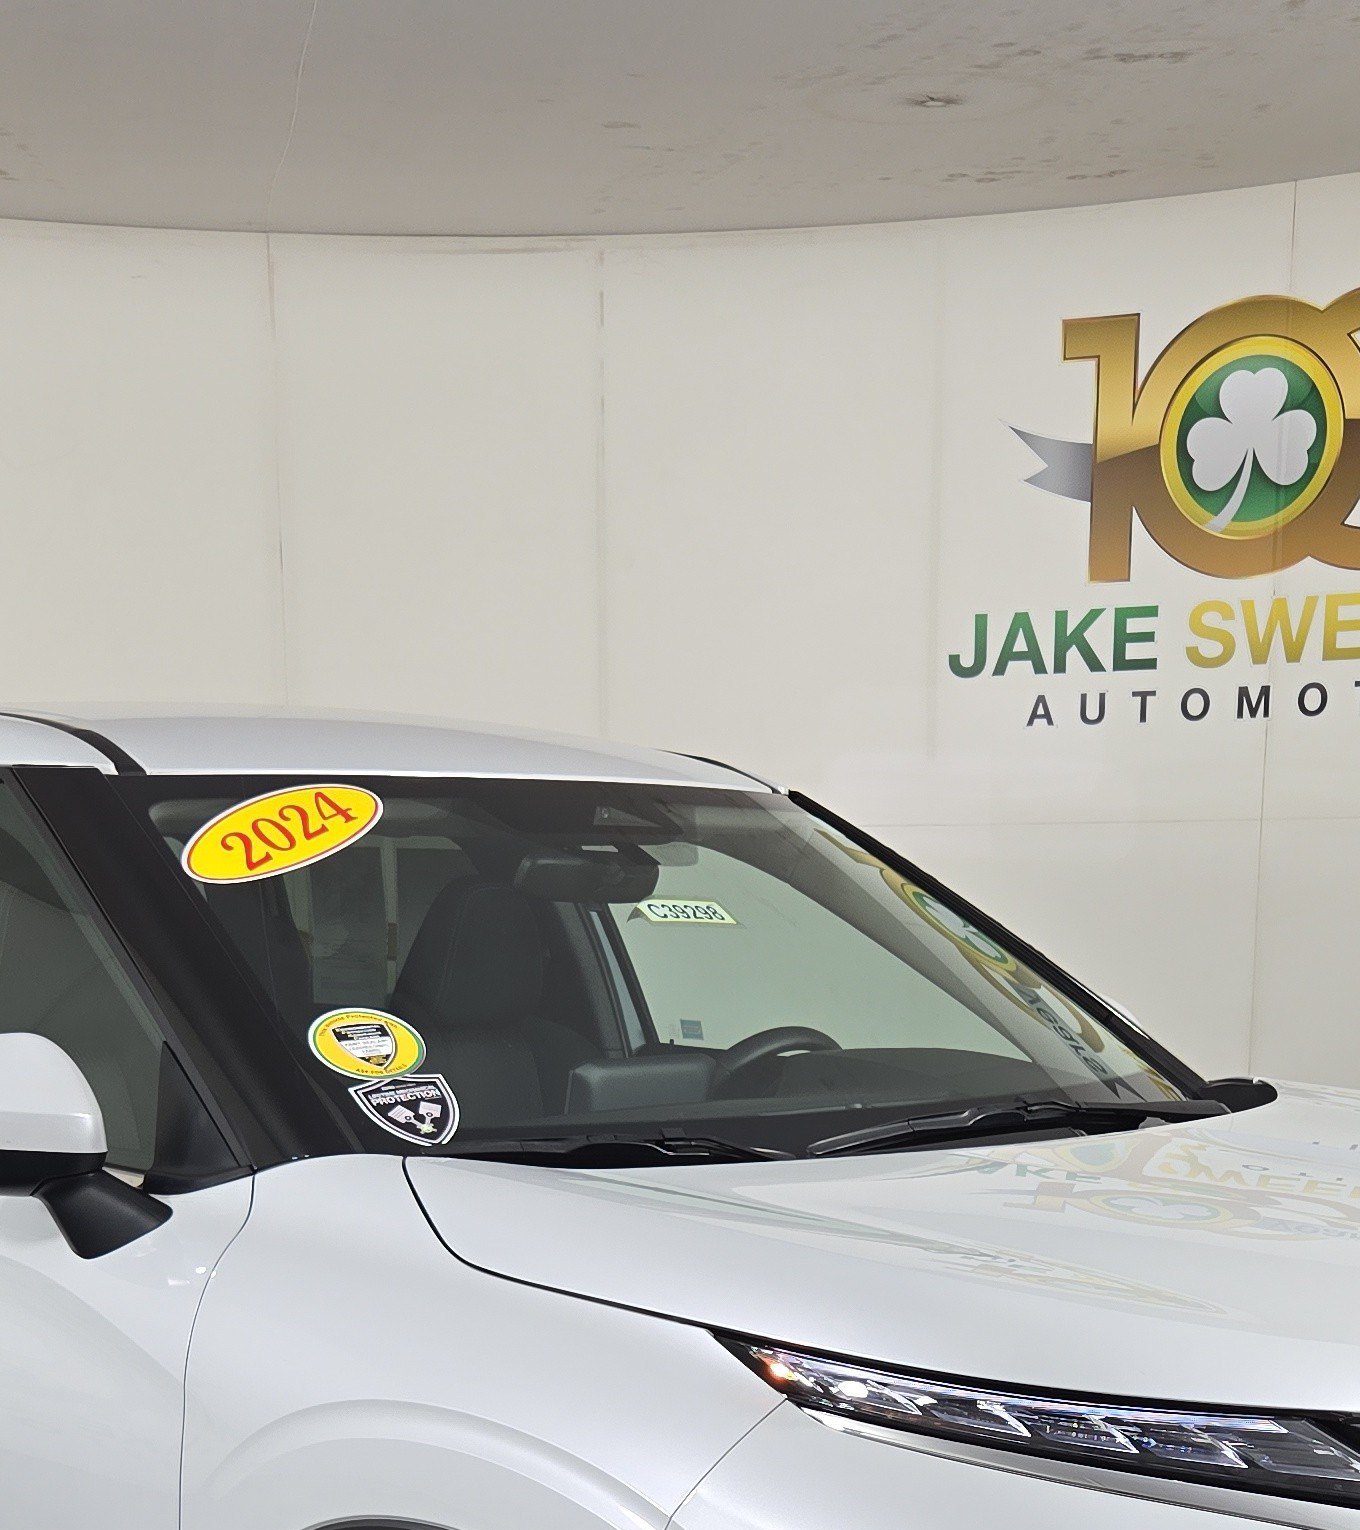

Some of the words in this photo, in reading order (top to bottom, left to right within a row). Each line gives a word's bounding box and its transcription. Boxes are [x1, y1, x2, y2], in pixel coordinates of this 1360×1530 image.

[948, 604, 1159, 679] JAKE
[220, 791, 358, 871] 2024
[647, 903, 726, 920] C39298
